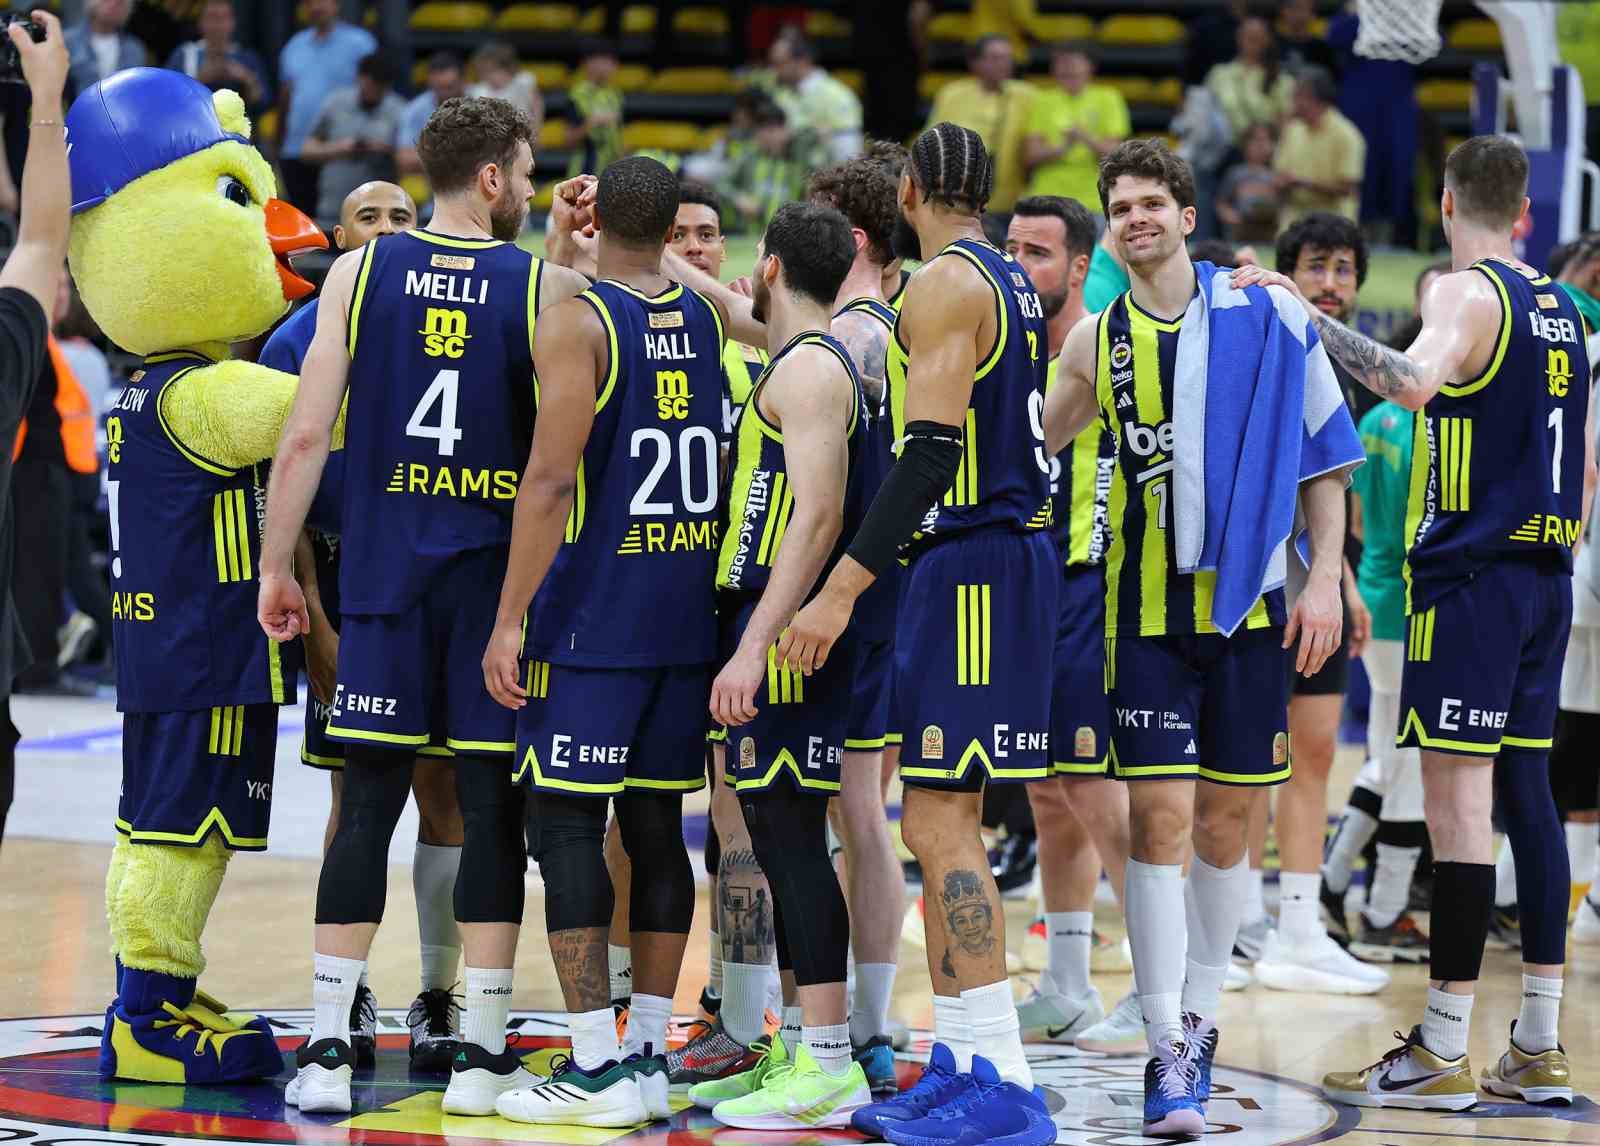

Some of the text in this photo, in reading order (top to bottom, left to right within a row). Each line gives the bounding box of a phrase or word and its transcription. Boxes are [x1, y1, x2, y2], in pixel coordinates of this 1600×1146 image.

[404, 269, 489, 304] MELLI
[644, 332, 697, 360] HALL
[1111, 370, 1133, 383] beko
[405, 369, 462, 456] 4
[1124, 418, 1174, 457] be
[1547, 407, 1564, 494] 1
[408, 462, 519, 499] RAMS
[629, 425, 719, 515] 20
[645, 520, 719, 552] RAMS
[1086, 503, 1109, 564] ACADEM
[727, 521, 755, 590] ACADEM
[112, 591, 155, 621] AMS
[313, 700, 332, 721] YK
[346, 693, 397, 716] ENEZ
[1115, 707, 1180, 728] YKT Filo
[578, 744, 629, 764] ENEZ
[1016, 732, 1048, 750] ENE
[246, 779, 272, 800] YK
[482, 986, 512, 995] adid
